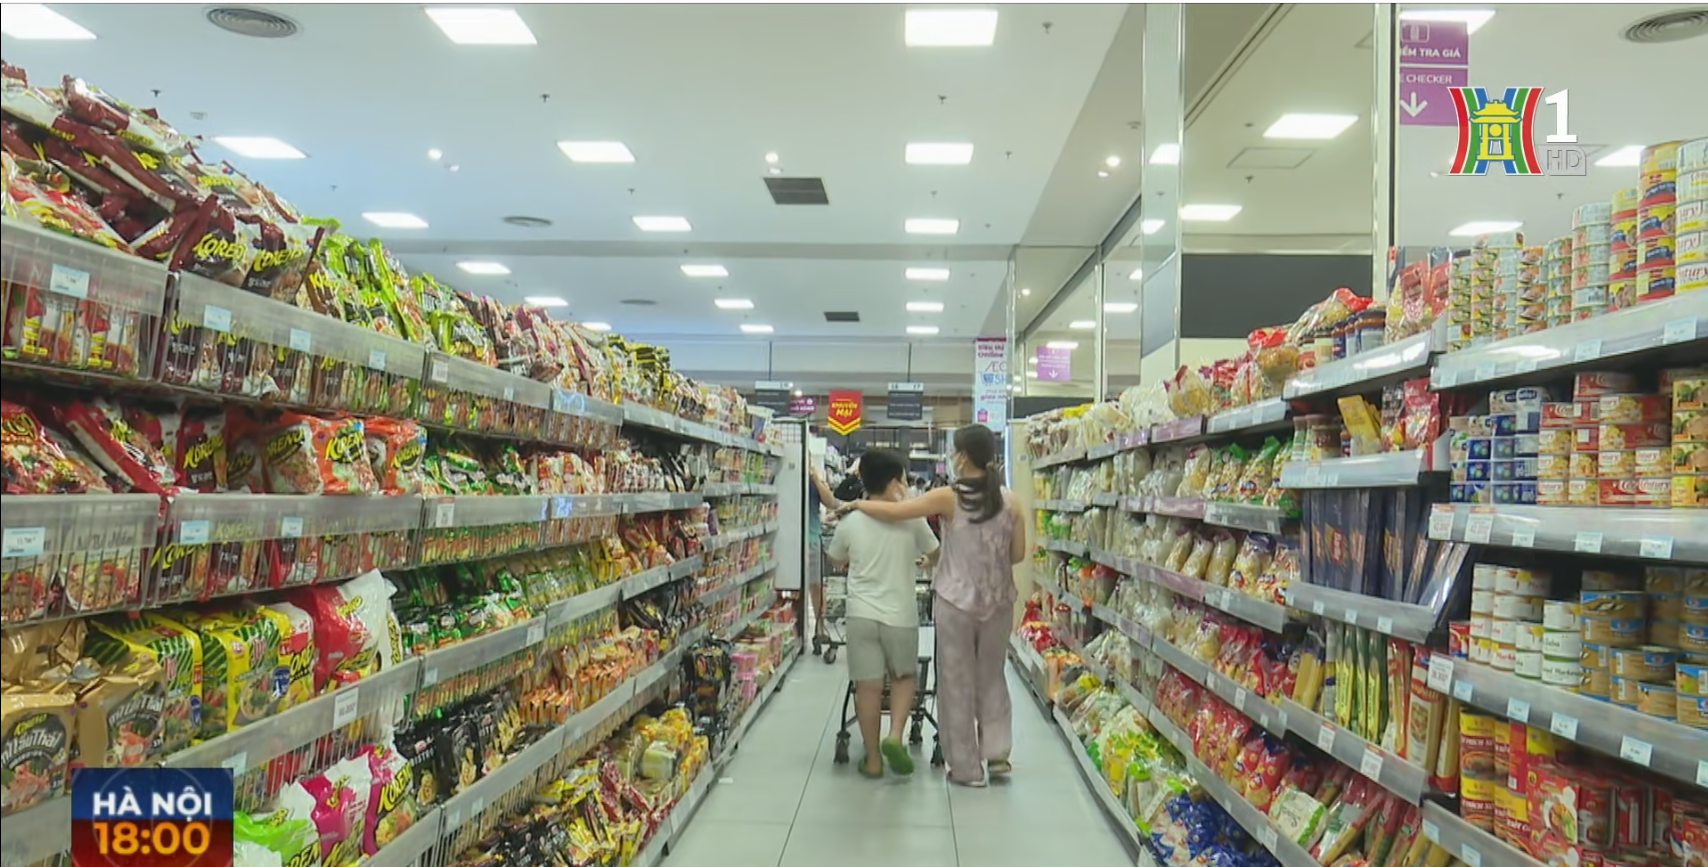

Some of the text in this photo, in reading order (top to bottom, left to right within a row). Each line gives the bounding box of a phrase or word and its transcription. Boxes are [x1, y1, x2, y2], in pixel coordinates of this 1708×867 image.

[1419, 47, 1440, 57] TRA
[1442, 45, 1461, 58] GIÁ
[1406, 74, 1452, 84] CHECKER
